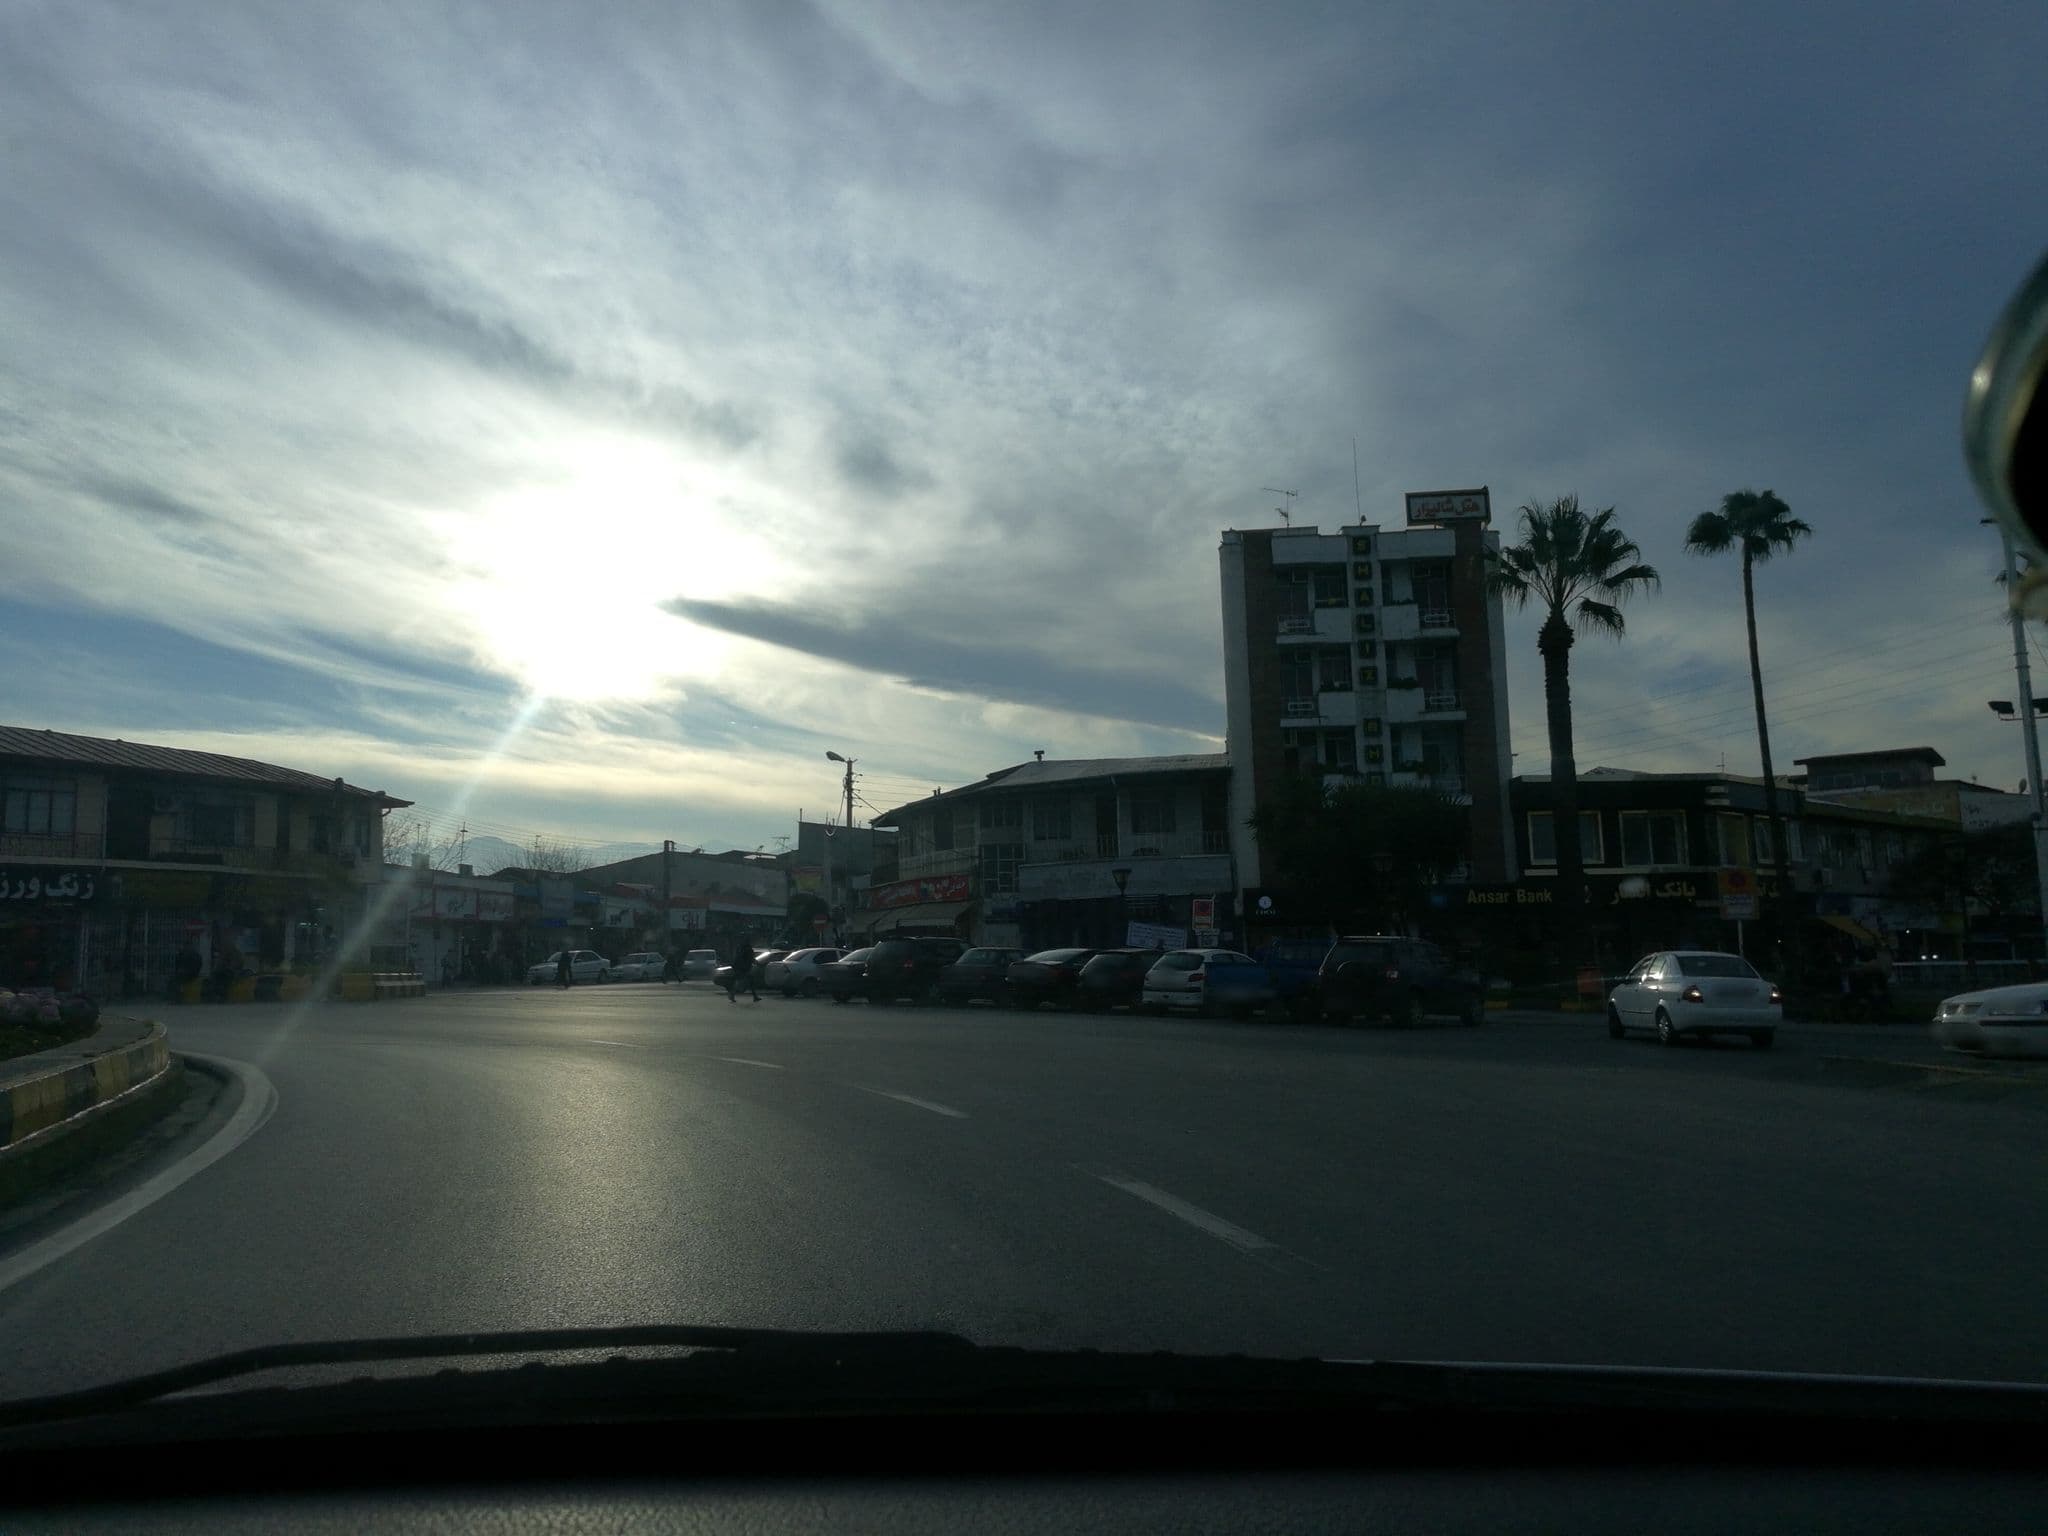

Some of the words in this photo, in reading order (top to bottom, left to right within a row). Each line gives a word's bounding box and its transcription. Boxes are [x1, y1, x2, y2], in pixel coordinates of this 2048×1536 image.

[1466, 887, 1511, 905] Ansar
[1516, 887, 1553, 905] Bank
[1655, 880, 1697, 904] بانک
